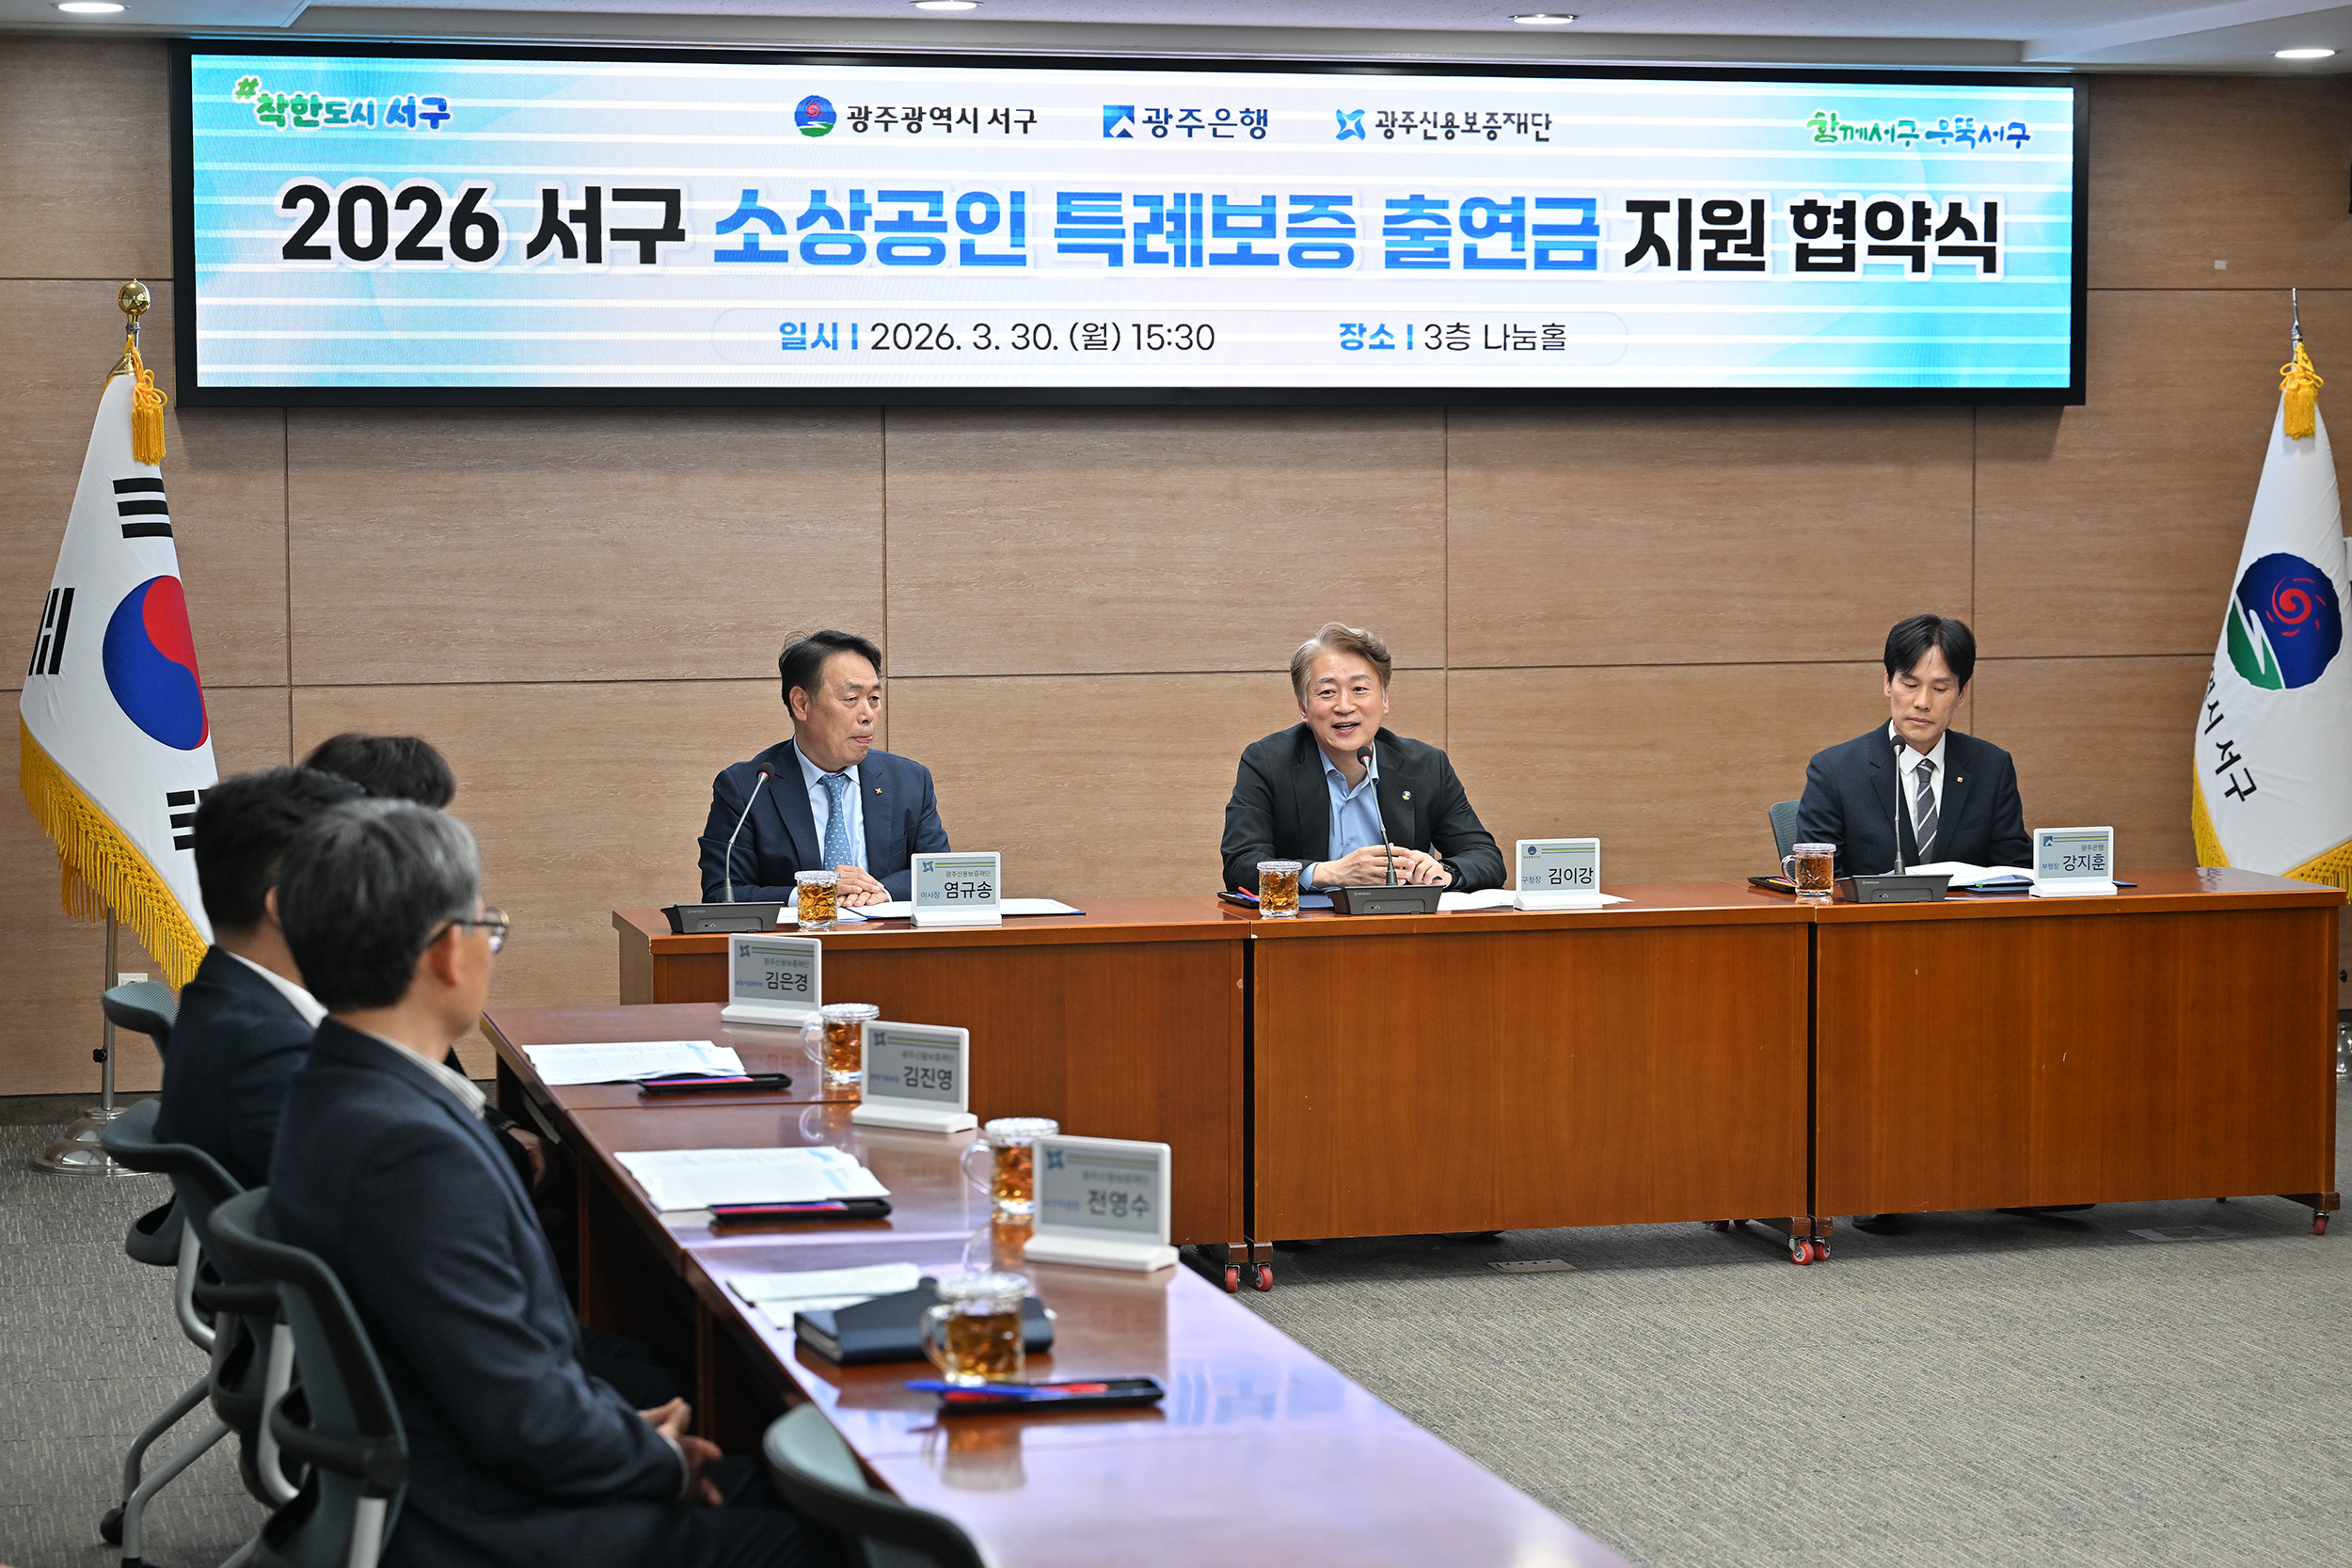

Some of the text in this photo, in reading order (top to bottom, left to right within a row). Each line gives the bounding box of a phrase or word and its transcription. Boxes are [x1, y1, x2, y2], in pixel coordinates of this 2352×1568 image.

[386, 96, 450, 129] 서구
[847, 104, 1038, 135] 광주광역시 서구
[1142, 107, 1268, 138] 광주은행
[1375, 110, 1552, 142] 광주신용보증재단
[1925, 118, 2031, 150] 우뚝서구
[281, 184, 1998, 274] 2026 서구 소상공인 특례보증 출연금 지원 협약식
[778, 322, 1216, 352] 일시 2026. 3. 30. (월) 15:30
[1340, 322, 1566, 351] 장소 3층 나눔홀
[2215, 739, 2257, 802] 서구
[946, 870, 991, 879] 광주신용보증재단
[1521, 867, 1594, 884] 구청장 김이강
[2062, 853, 2106, 872] 강지훈
[920, 880, 993, 899] 이사장 염규송
[766, 972, 808, 991] 김은경
[904, 1065, 952, 1091] 김진영
[1088, 1188, 1150, 1218] 전영수
